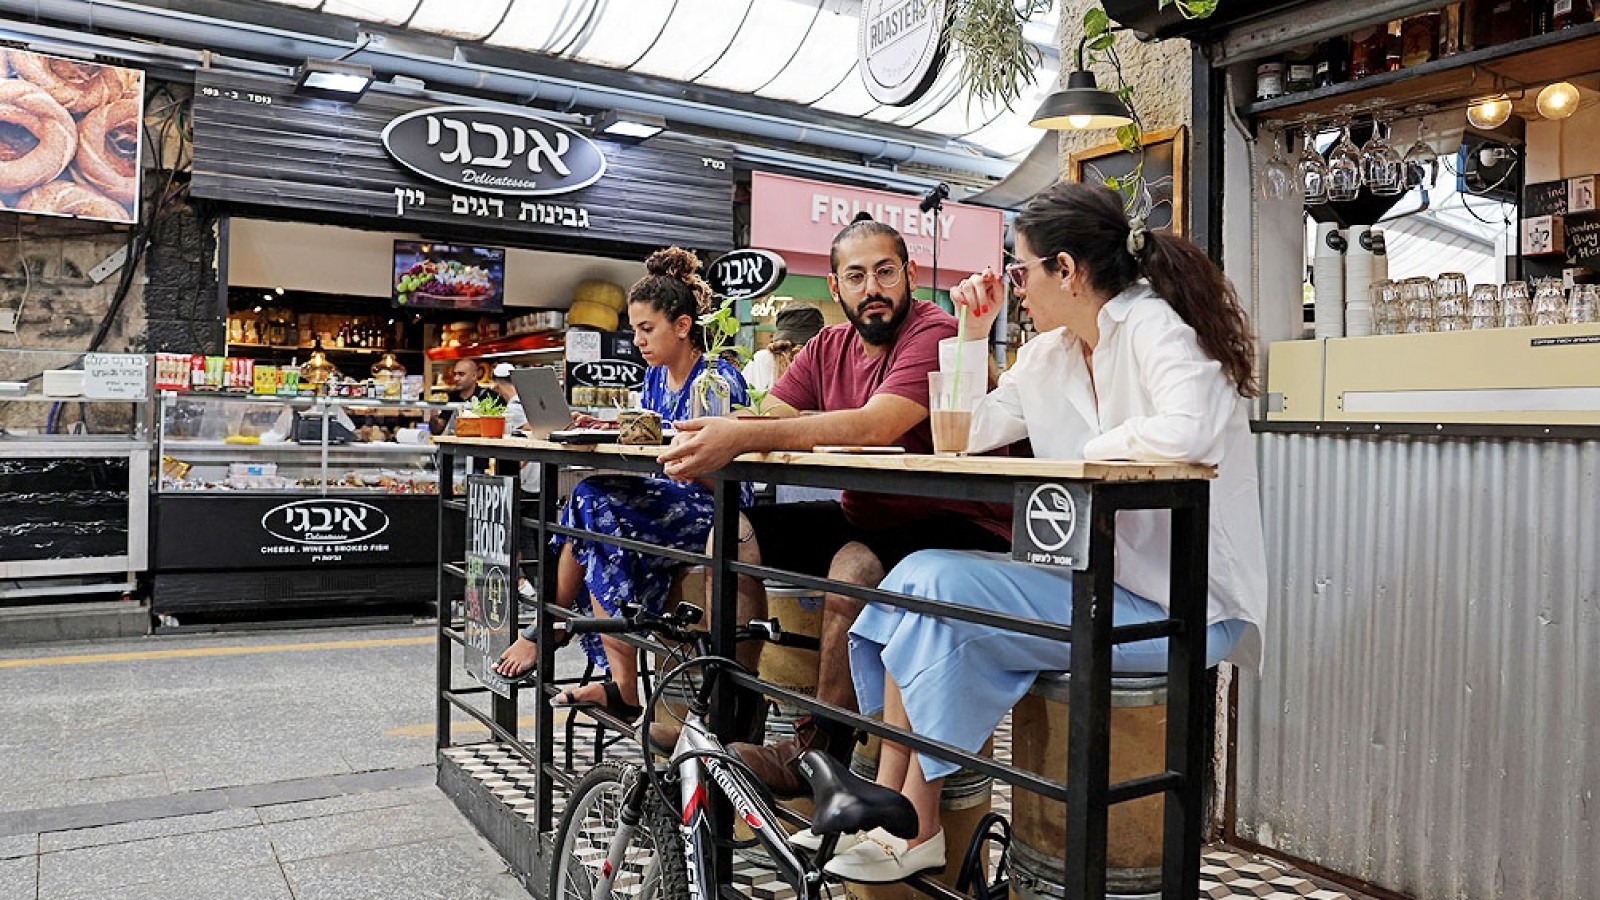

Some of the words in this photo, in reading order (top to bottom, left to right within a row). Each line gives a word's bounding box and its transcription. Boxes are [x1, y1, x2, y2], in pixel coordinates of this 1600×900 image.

[427, 115, 572, 176] איבגי
[461, 169, 537, 189] Delicatessen
[394, 188, 425, 216] יין
[451, 194, 505, 218] דגים
[518, 201, 591, 228] גבינות
[717, 256, 764, 286] איבגי
[587, 363, 639, 382] איבגי
[468, 481, 508, 525] HAPPY
[285, 507, 367, 532] איבגי
[302, 545, 324, 553] WINE
[334, 544, 369, 553] SMOKED
[472, 519, 510, 565] HOUR
